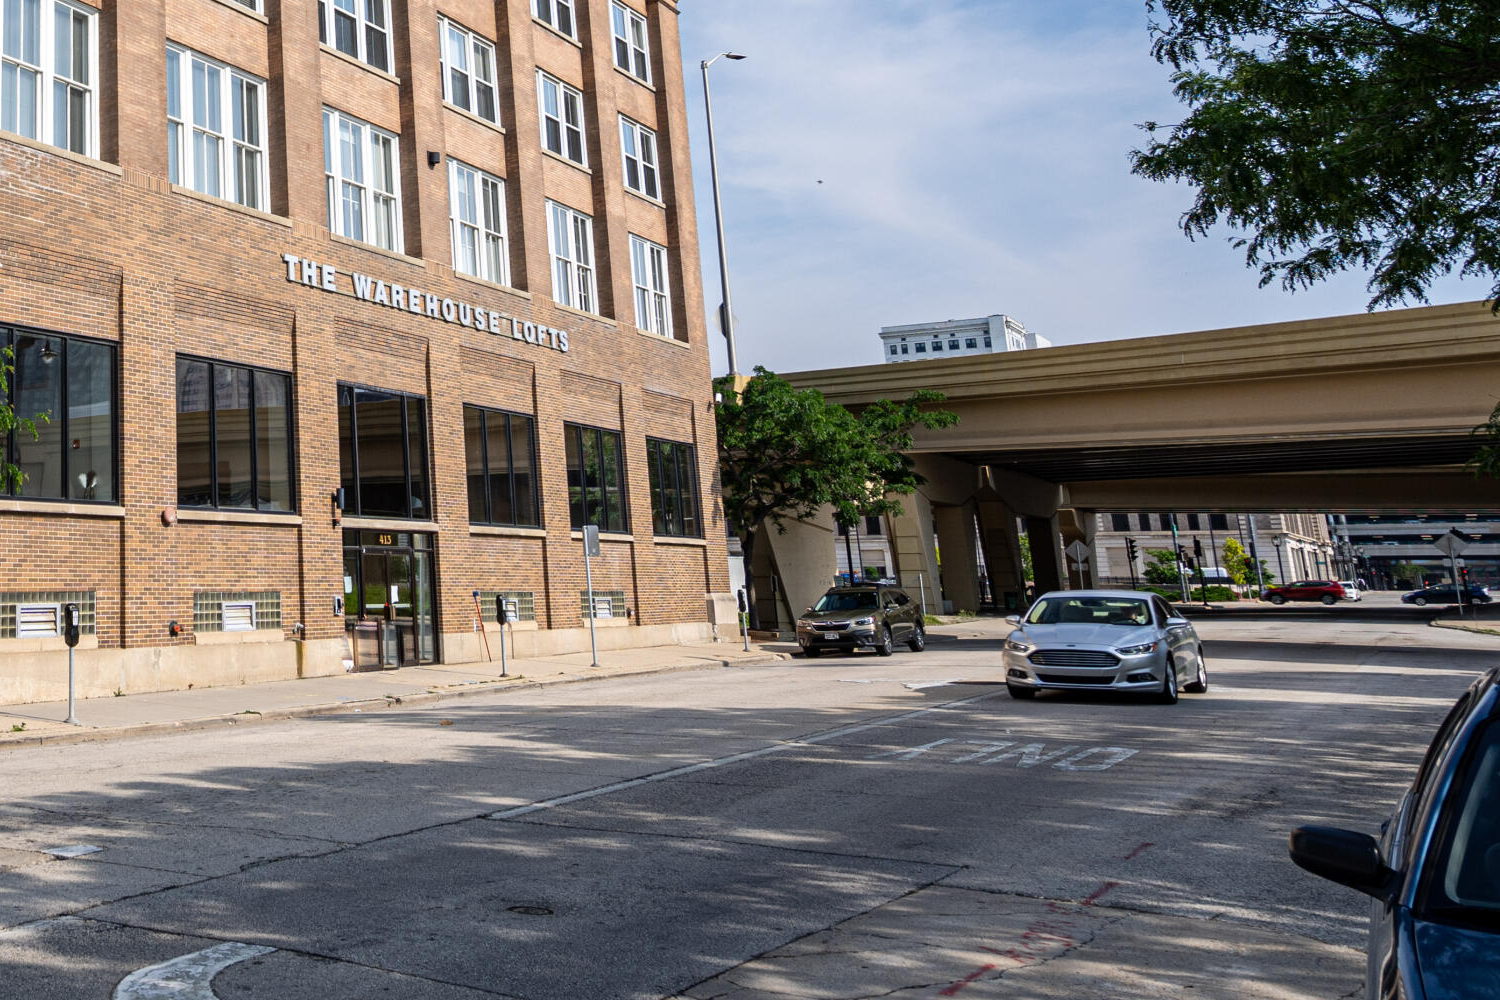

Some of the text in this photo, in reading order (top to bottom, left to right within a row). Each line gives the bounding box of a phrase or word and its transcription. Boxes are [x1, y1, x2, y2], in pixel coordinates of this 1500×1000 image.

[284, 253, 569, 352] THE WAREHOUSE LOFTS
[380, 535, 391, 544] 413
[866, 737, 1141, 772] ONLY
